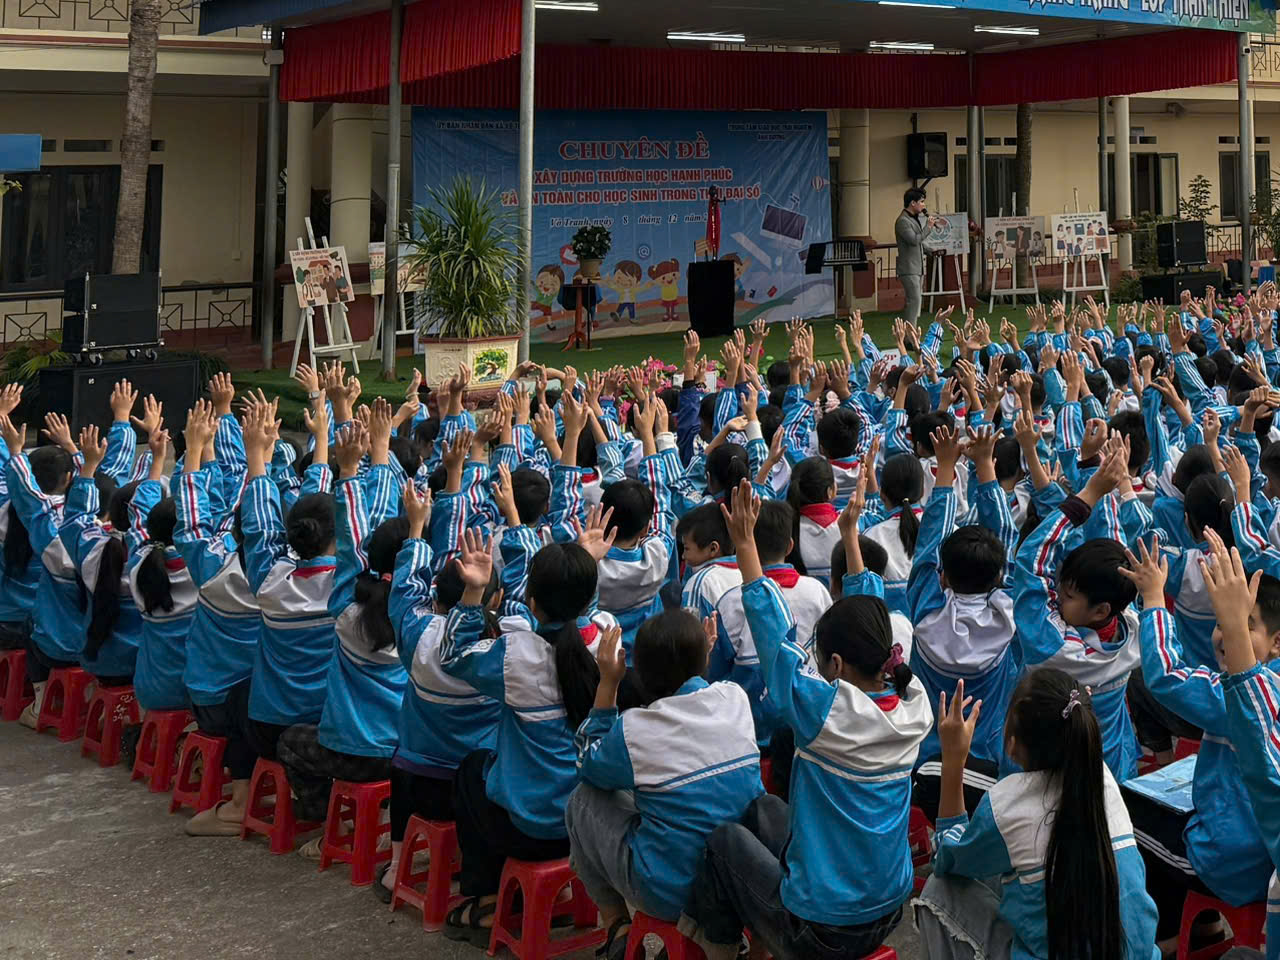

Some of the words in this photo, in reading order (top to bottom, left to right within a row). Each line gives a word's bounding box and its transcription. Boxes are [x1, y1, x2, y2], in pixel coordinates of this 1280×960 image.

[559, 136, 669, 160] CHUYÊN
[676, 130, 710, 159] ĐỀ
[534, 168, 558, 184] XÂY
[561, 170, 594, 187] DỰNG
[597, 167, 642, 183] TRƯỜNG
[645, 169, 669, 185] HỌC
[671, 168, 701, 184] HẠNH
[703, 165, 733, 181] PHÚC
[542, 188, 574, 205] TOÀN
[576, 191, 601, 205] CHO
[603, 190, 628, 206] HỌC
[630, 189, 658, 202] SINH
[660, 187, 697, 201] TRONG
[724, 186, 744, 202] ĐẠI
[745, 181, 761, 199] SỐ
[623, 216, 629, 225] 8
[638, 215, 661, 225] tháng
[668, 214, 678, 224] 12
[684, 213, 701, 223] năm
